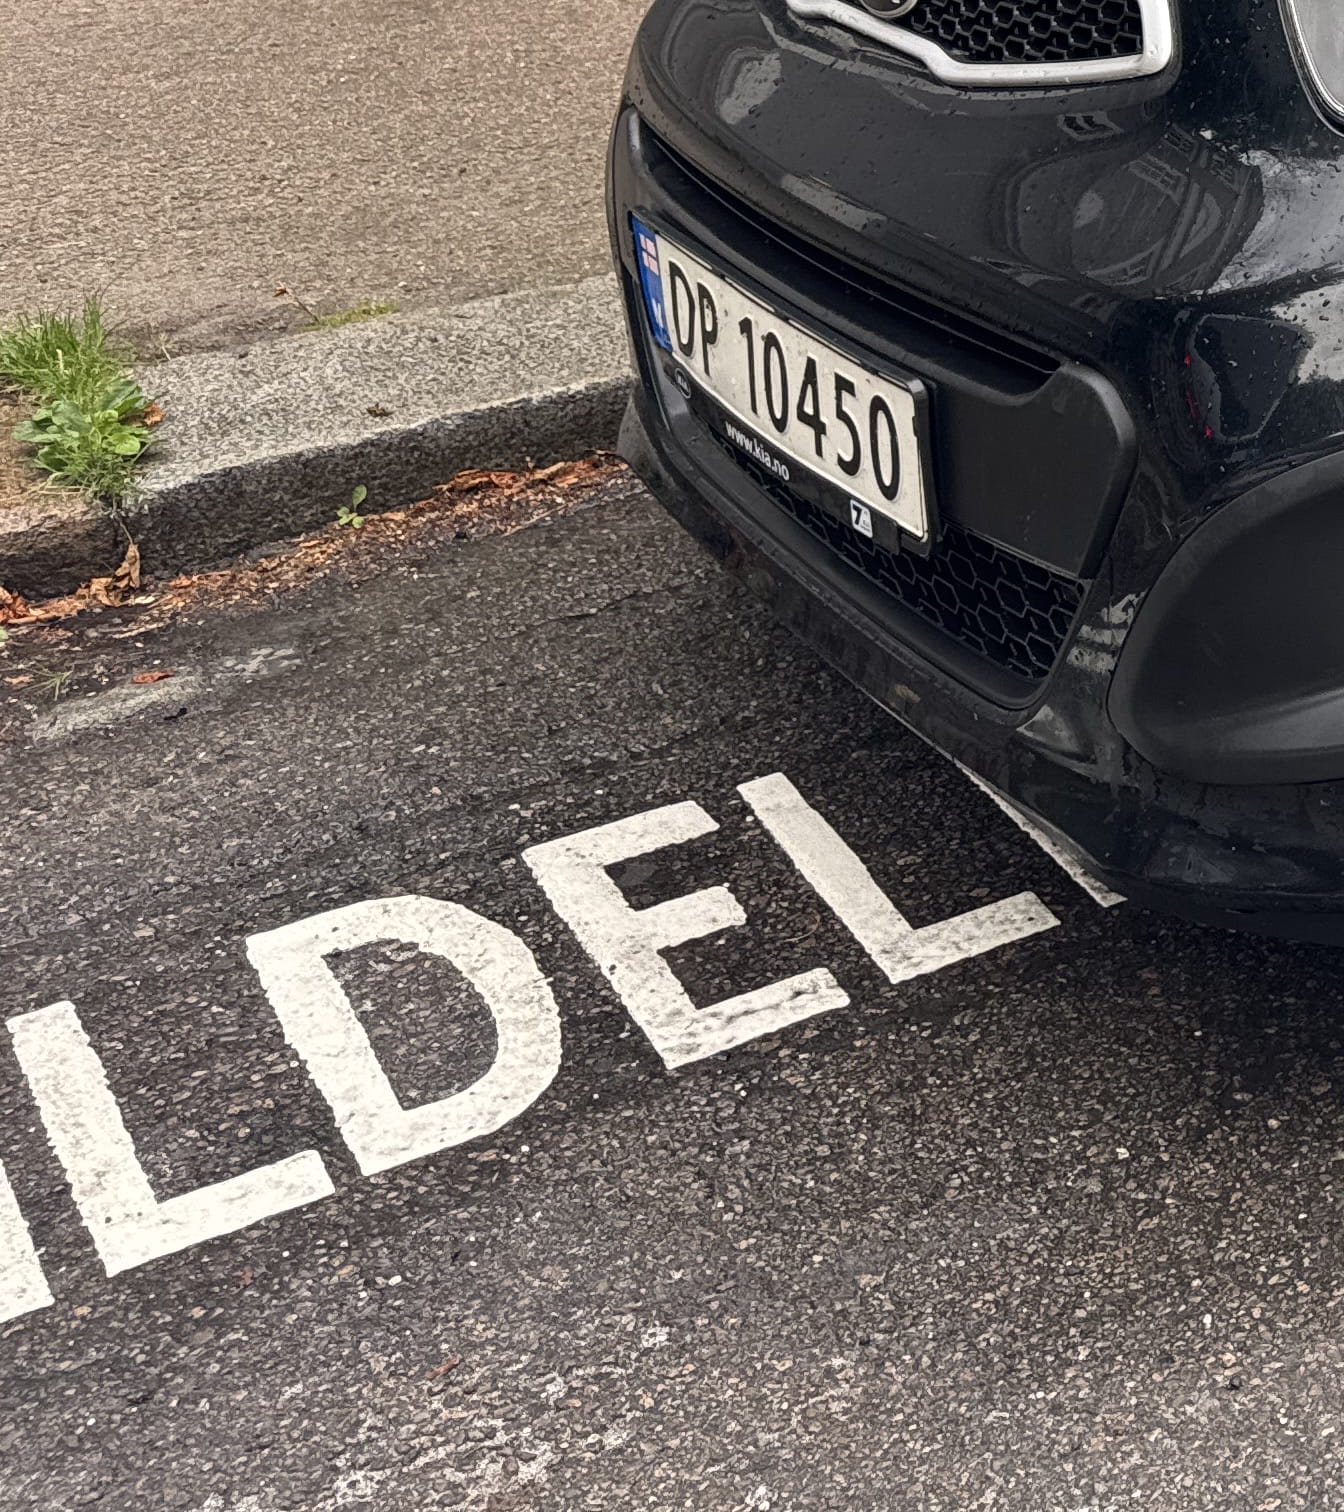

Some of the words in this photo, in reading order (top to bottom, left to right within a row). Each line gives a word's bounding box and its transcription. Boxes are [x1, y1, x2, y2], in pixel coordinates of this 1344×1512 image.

[668, 259, 718, 377] DP
[738, 316, 900, 502] 10450
[725, 420, 790, 481] www.kia.no
[0, 772, 1127, 1324] LDEL
